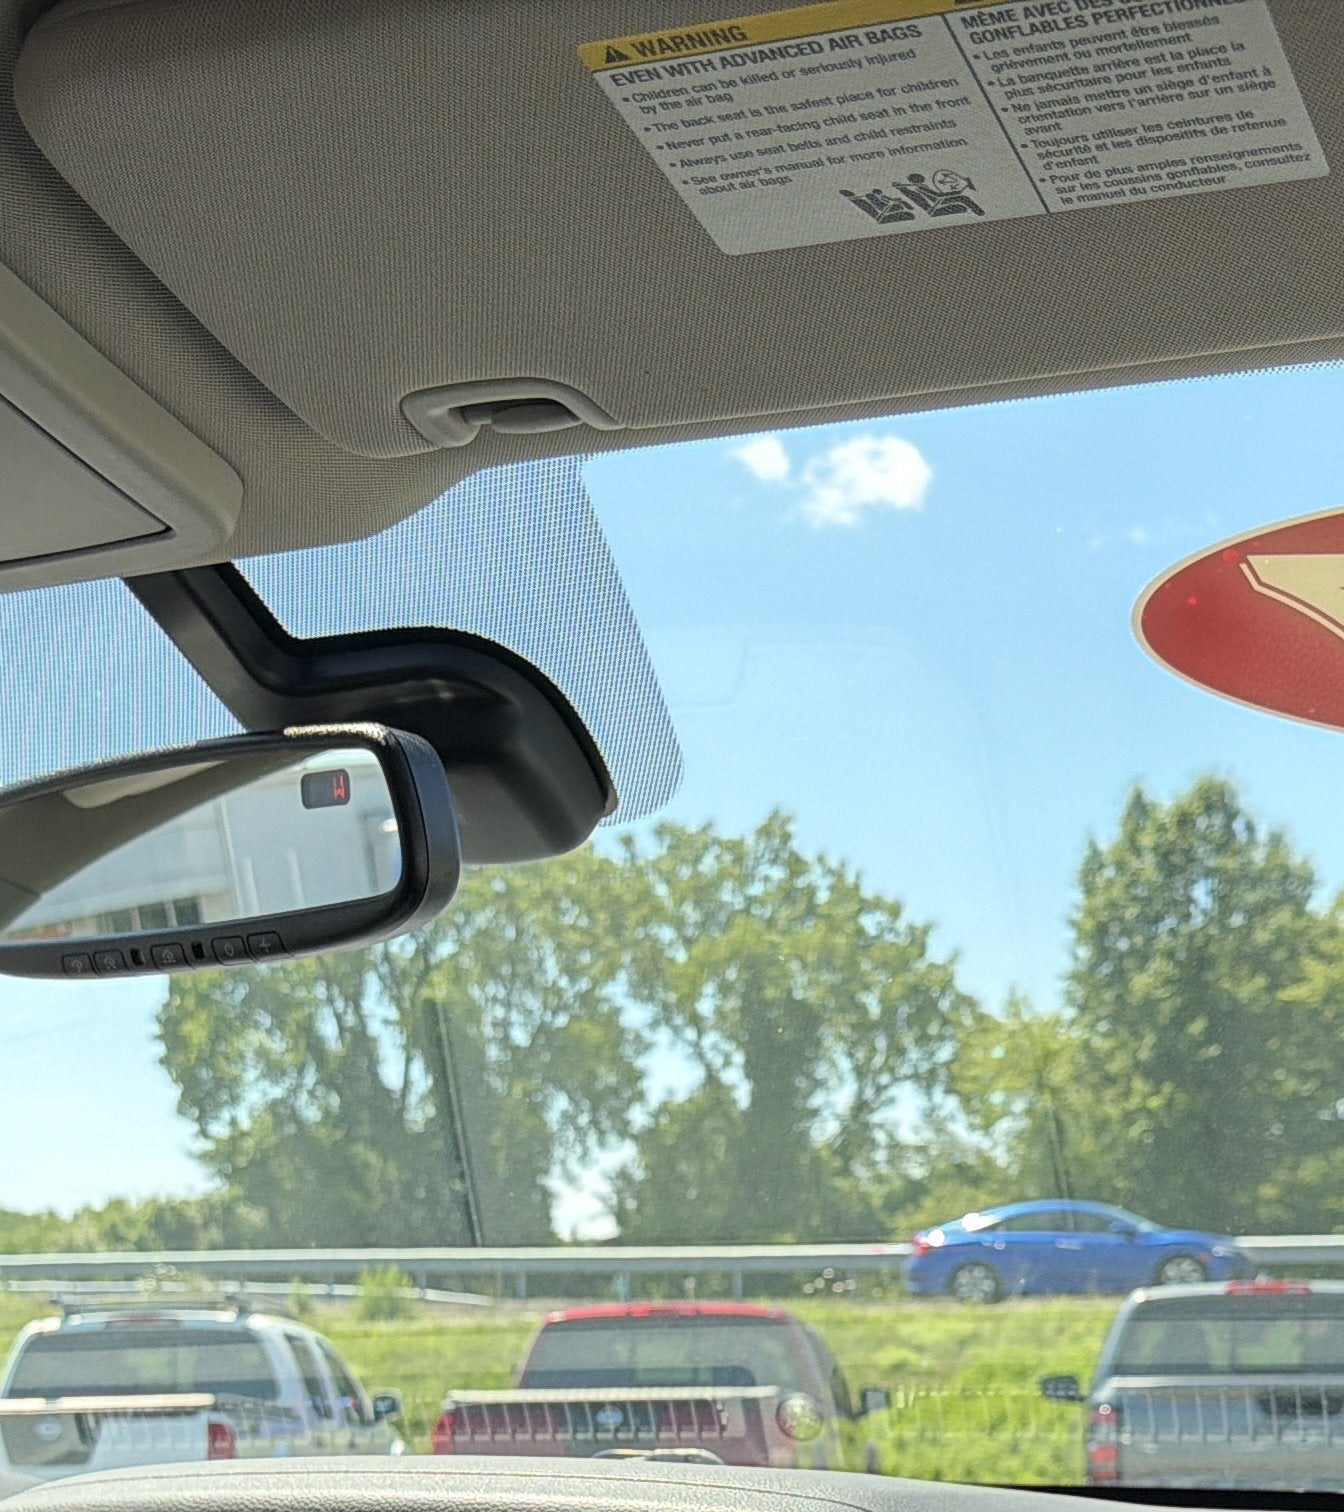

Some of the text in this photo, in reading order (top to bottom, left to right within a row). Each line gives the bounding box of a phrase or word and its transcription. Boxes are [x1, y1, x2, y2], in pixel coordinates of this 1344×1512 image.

[957, 6, 1019, 29] MÊME
[1019, 0, 1073, 20] AVEC
[967, 14, 1090, 45] GONFLABLES
[982, 14, 1221, 61] Les enfants peuvent être blessés
[607, 24, 923, 87] EVEN WITH ADVANCED AIR BAGS
[631, 25, 748, 58] WARNING
[988, 32, 1193, 75] grièvement ou mortellement
[996, 40, 1246, 88] La banquette arrière est la place la
[629, 49, 919, 103] Children can be killed or seriously injured
[1002, 55, 1232, 101] plus sécuritaire pour les enfants
[1010, 65, 1272, 114] Ne jamais mettre un siège d'enfant à
[637, 90, 735, 116] by the air bag
[650, 76, 959, 132] The back seat is the safest place for children
[663, 96, 972, 150] Never put a rear-facing child seat in the front
[676, 118, 958, 170] Always use seat belts and child restraints
[1030, 108, 1254, 152] Toujours utiliser les ceintures de
[688, 137, 969, 186] See owner's manual for more information
[1048, 140, 1303, 185] Pour de plus amples renseignements
[696, 174, 795, 196] about air bags
